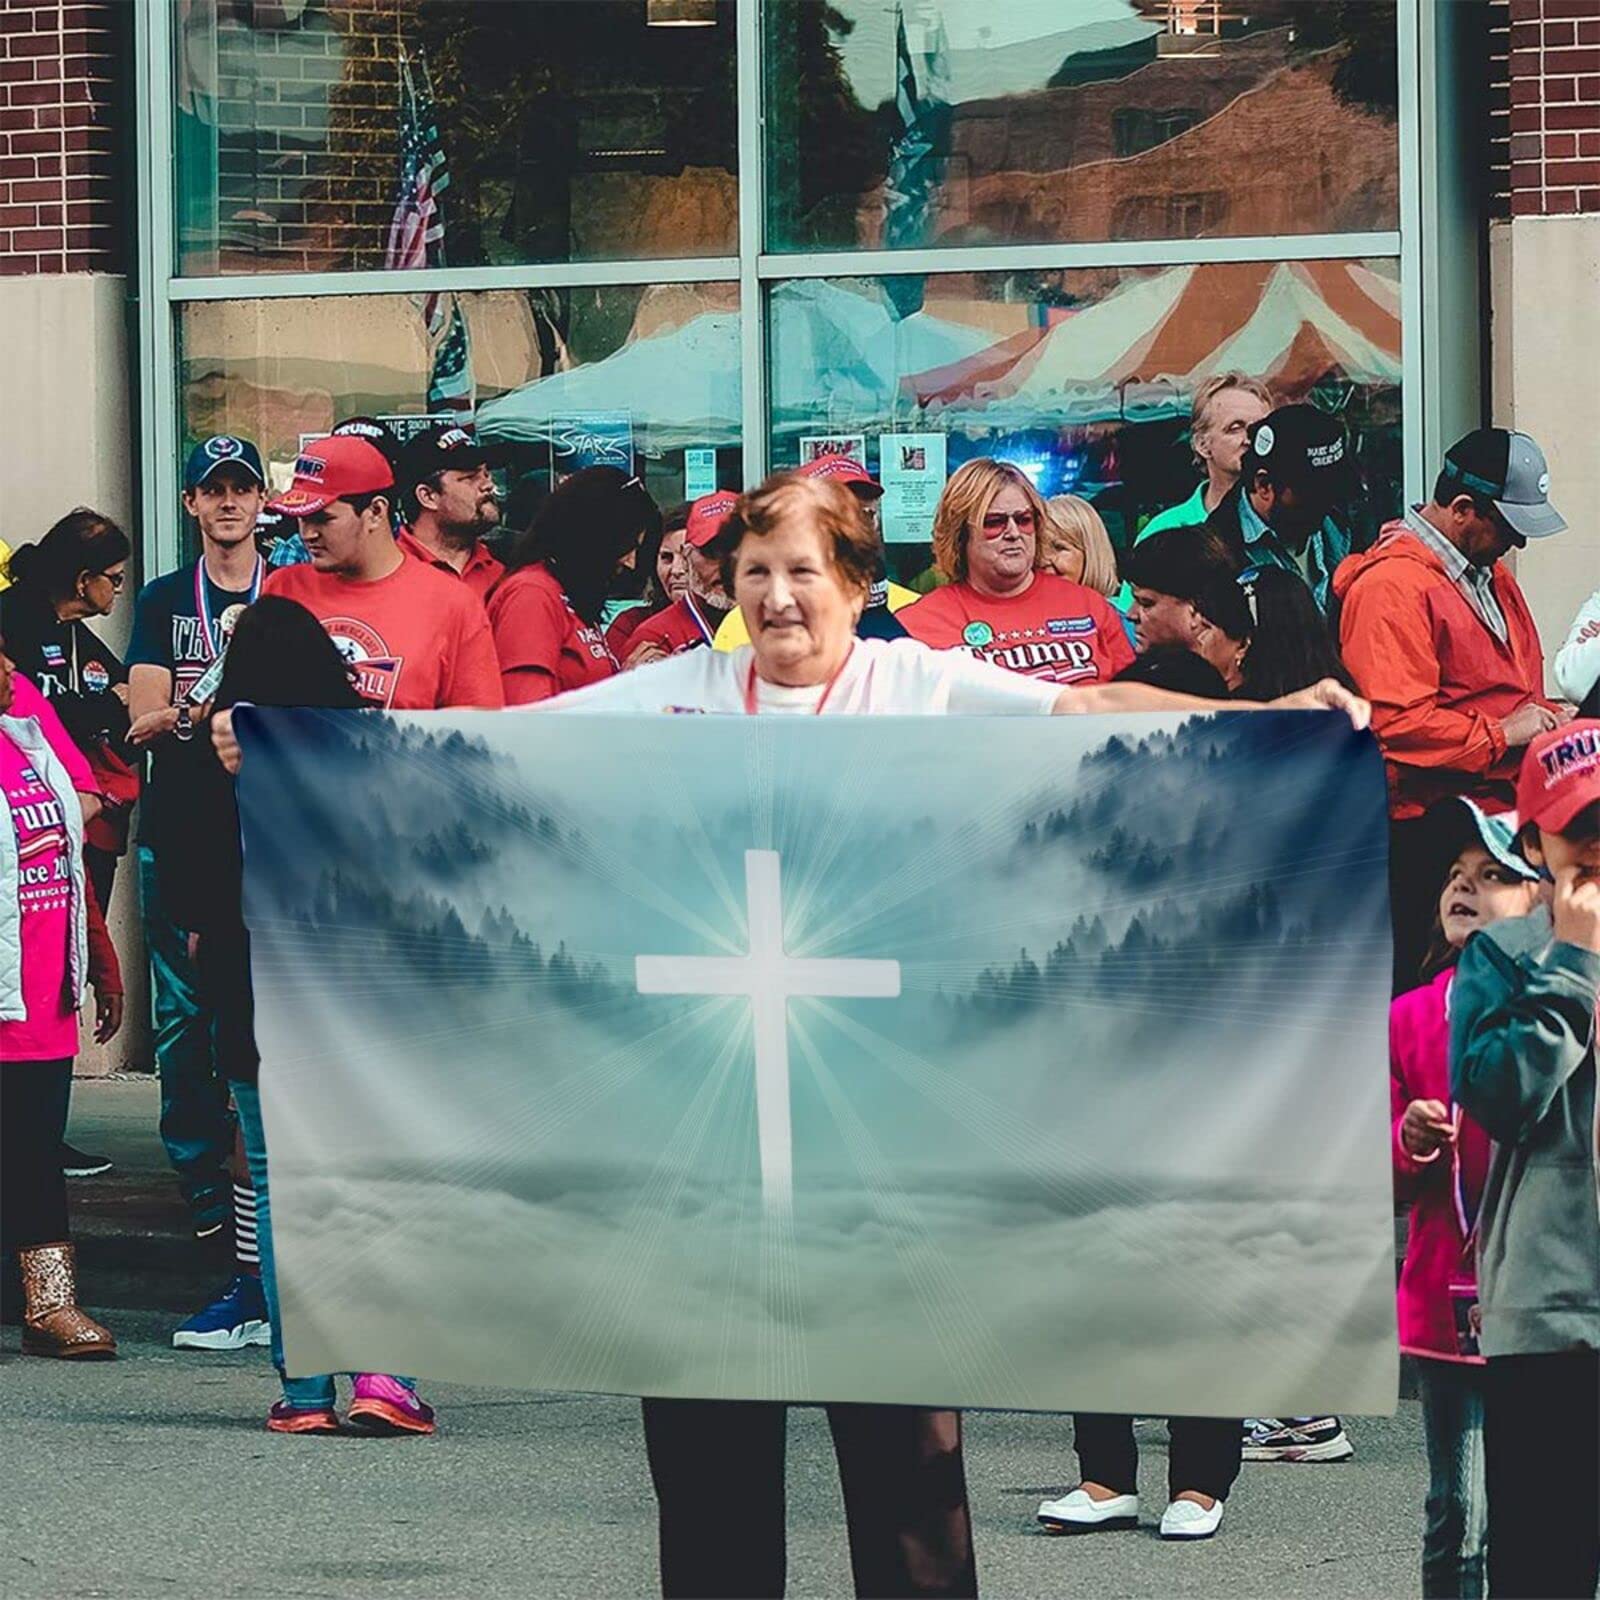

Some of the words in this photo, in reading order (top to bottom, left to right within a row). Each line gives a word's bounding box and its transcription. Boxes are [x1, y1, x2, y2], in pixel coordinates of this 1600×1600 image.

[334, 422, 383, 438] TRUMP
[556, 429, 628, 459] STARZ
[349, 671, 386, 696] ALL
